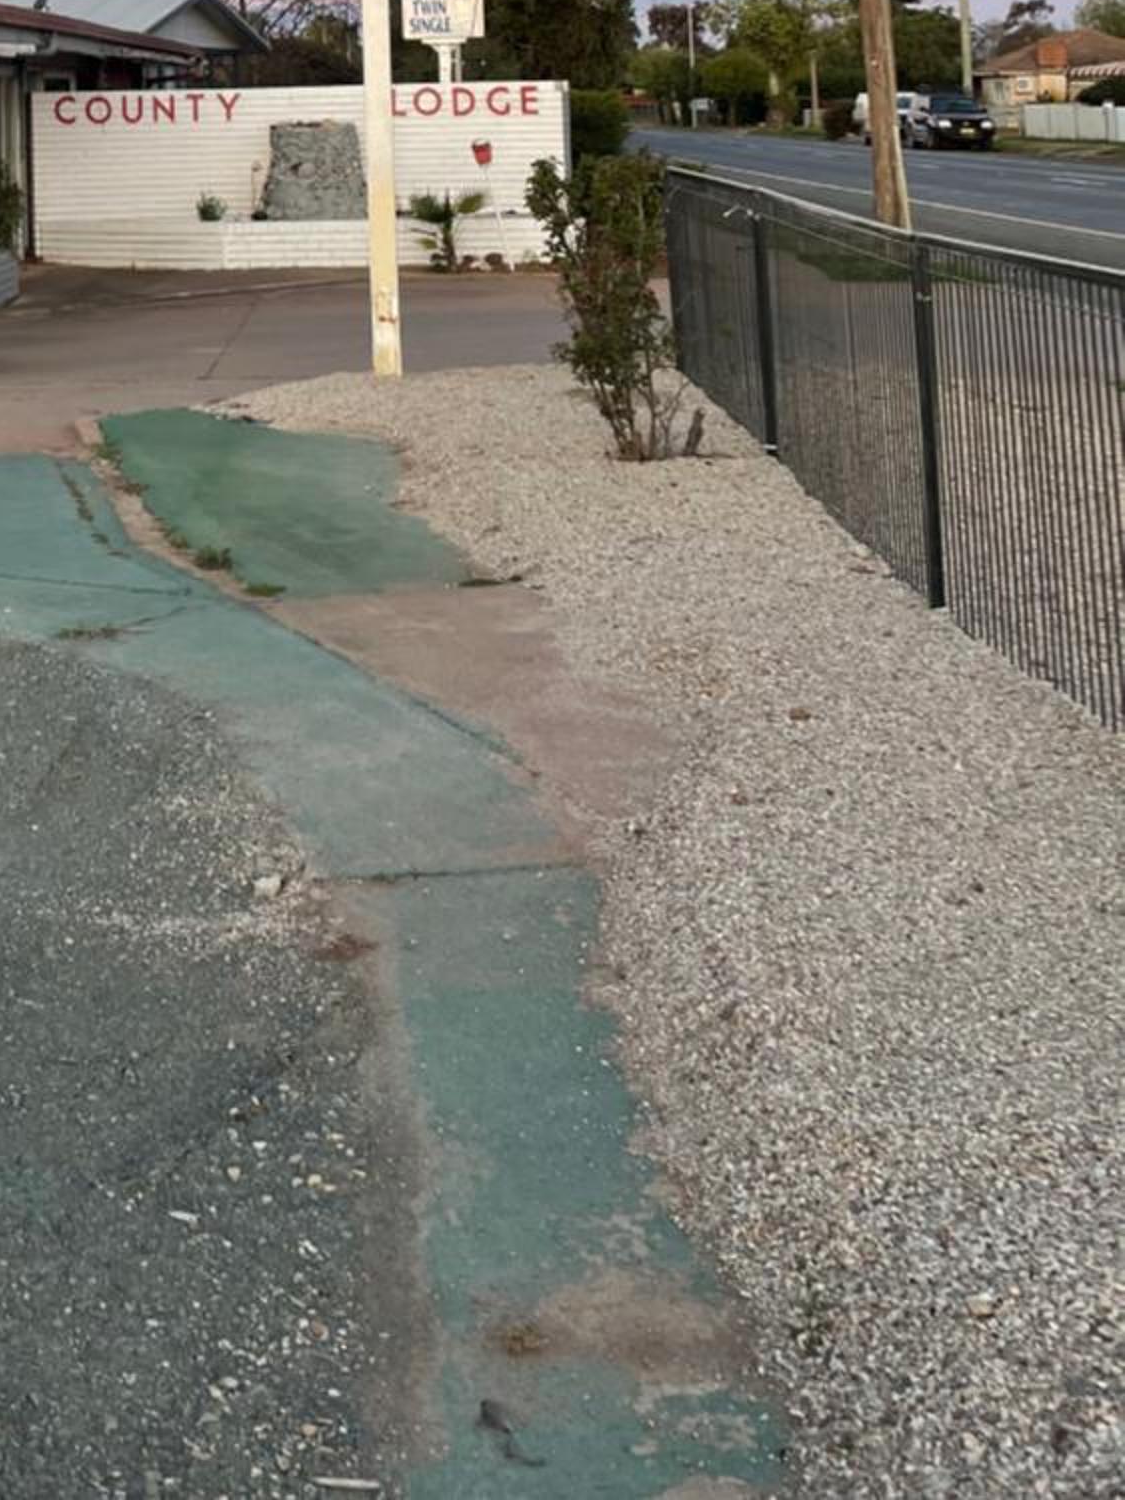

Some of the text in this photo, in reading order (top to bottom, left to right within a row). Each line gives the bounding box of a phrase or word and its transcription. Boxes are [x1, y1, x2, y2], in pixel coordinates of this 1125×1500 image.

[412, 0, 447, 15] TWIN
[409, 16, 451, 33] SINGLE
[53, 85, 540, 125] COUNTY LODGE
